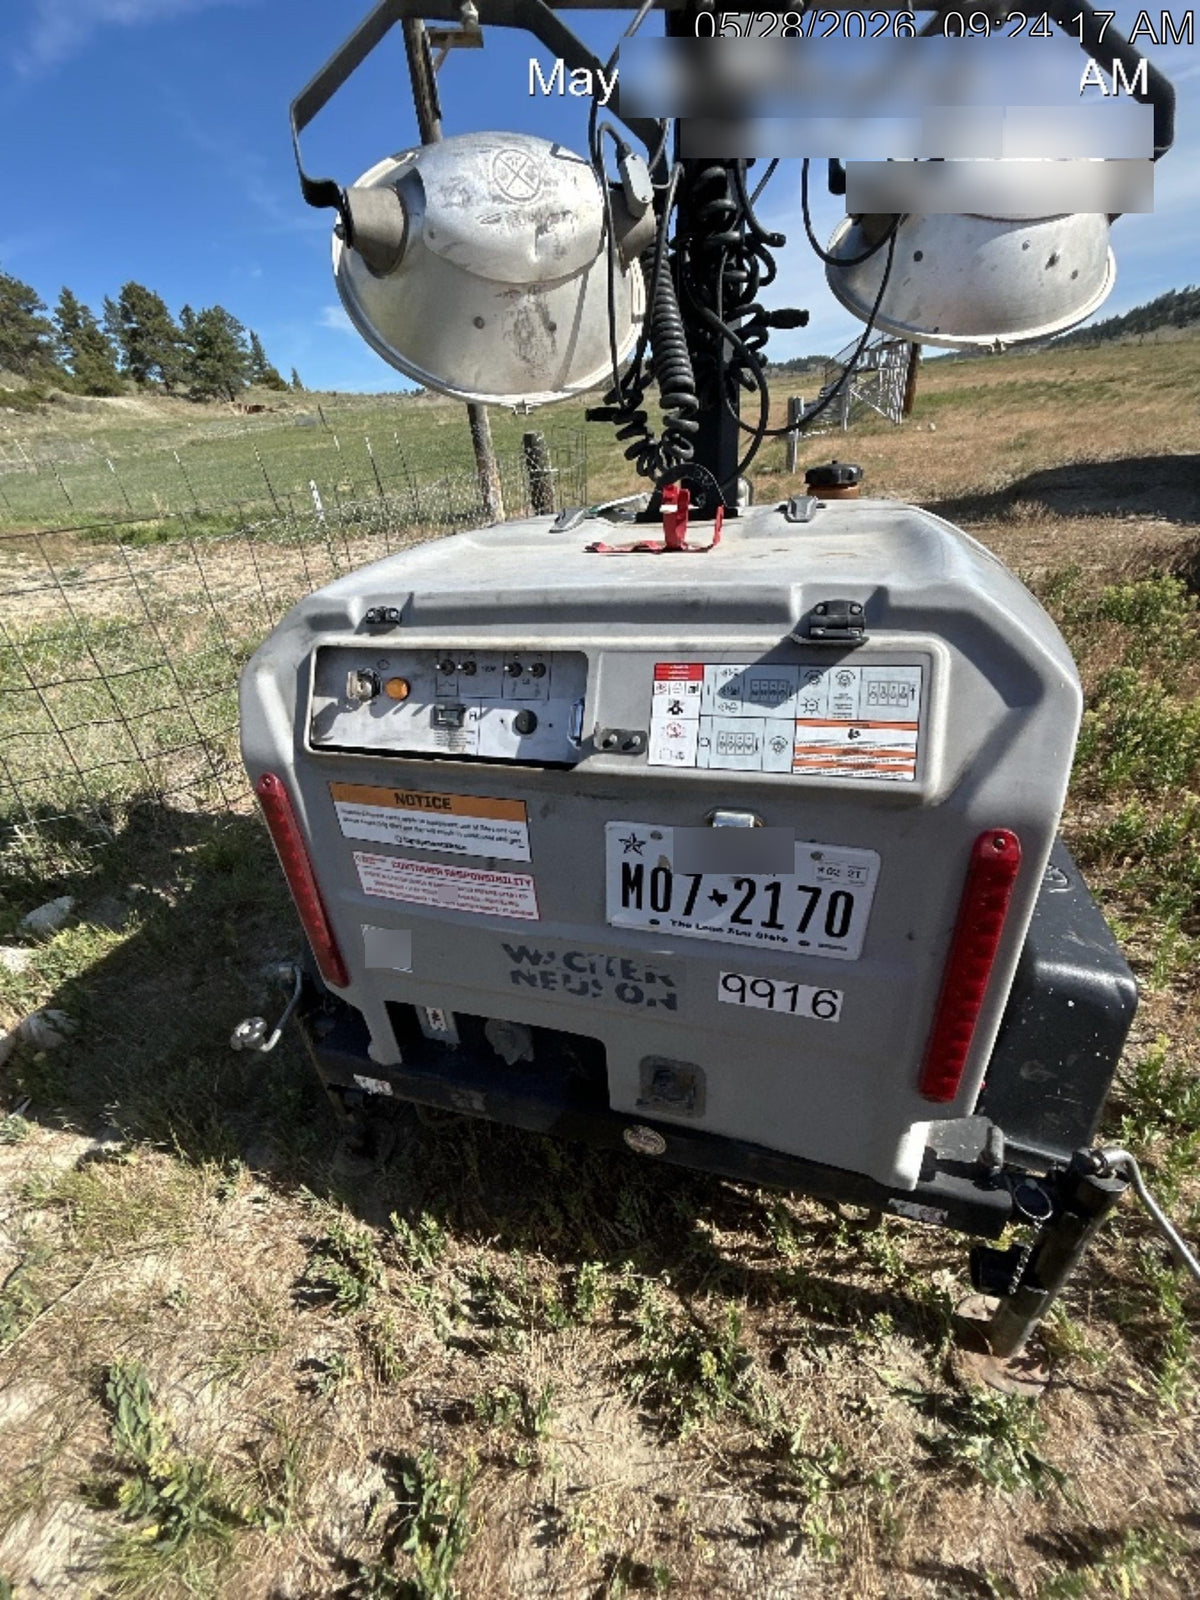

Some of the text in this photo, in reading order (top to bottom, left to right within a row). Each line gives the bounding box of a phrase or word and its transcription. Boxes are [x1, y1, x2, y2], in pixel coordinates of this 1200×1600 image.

[394, 792, 452, 810] NOTICE
[669, 919, 692, 930] The
[755, 931, 789, 944] State
[721, 973, 838, 1019] 9916
